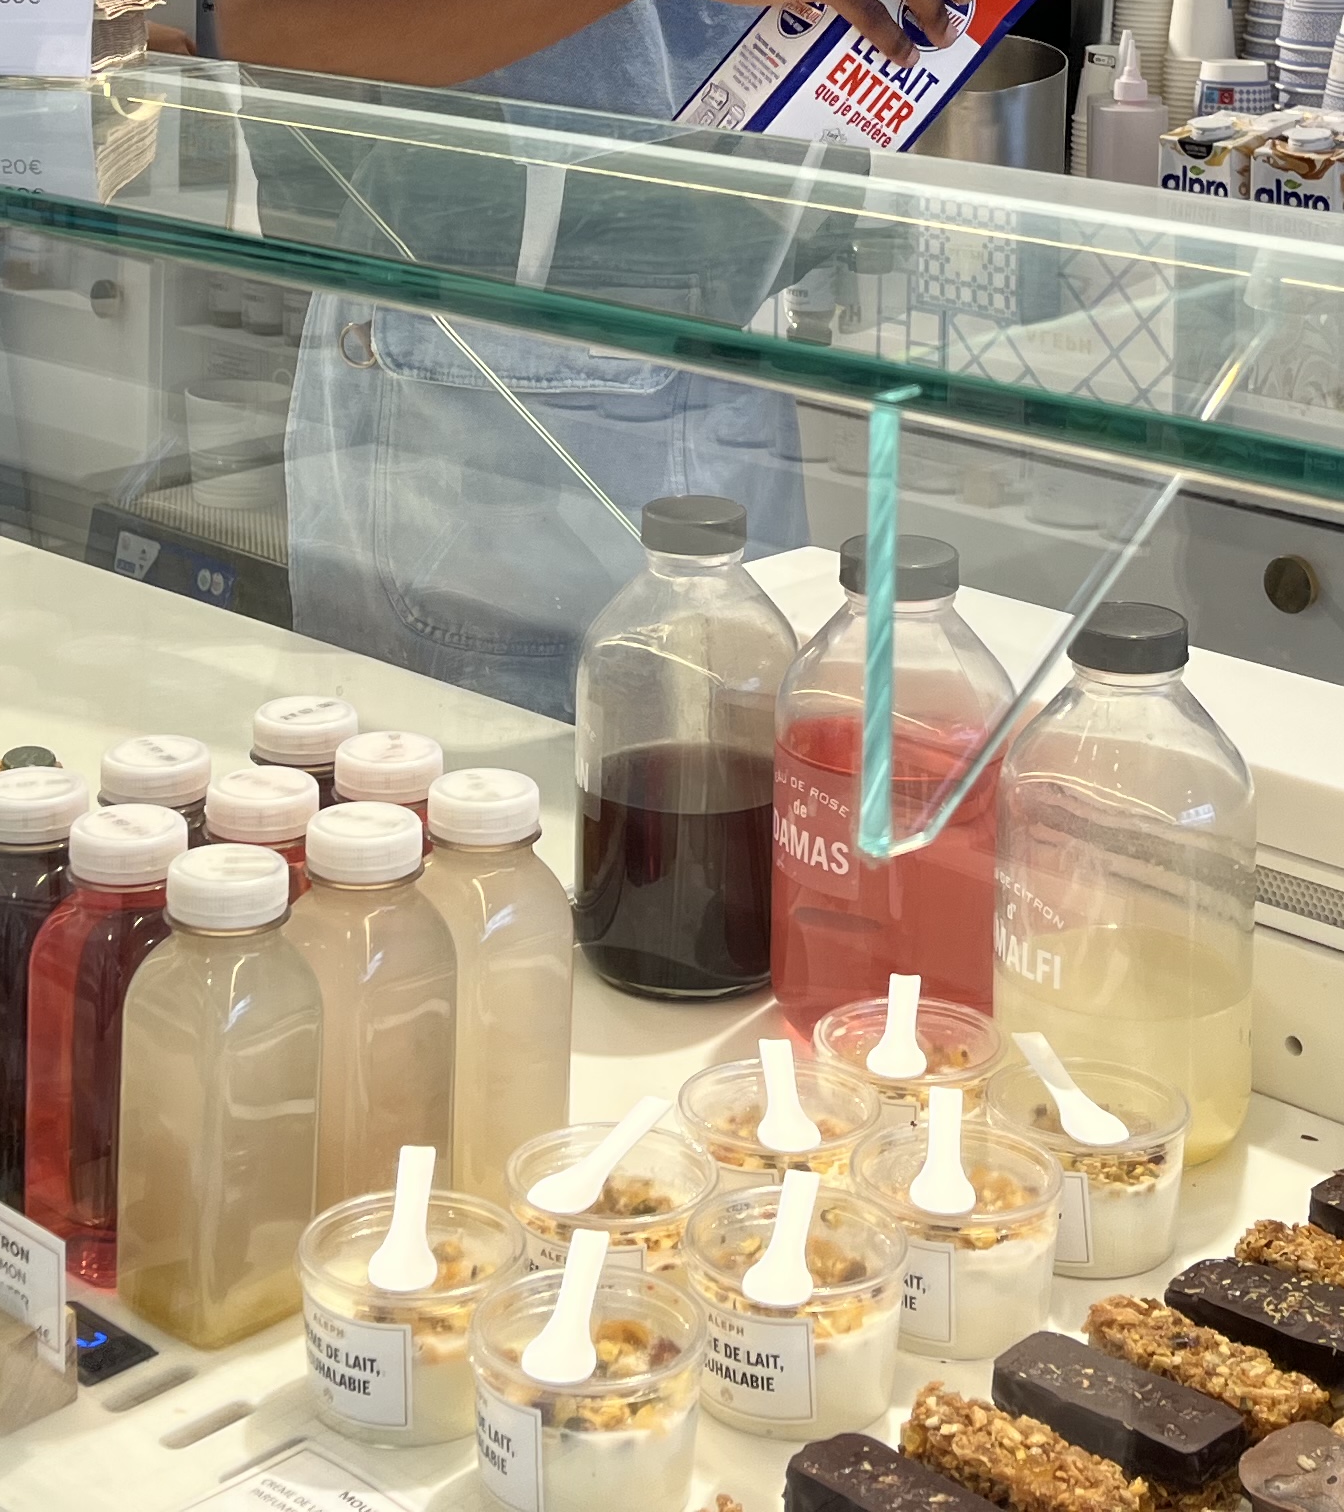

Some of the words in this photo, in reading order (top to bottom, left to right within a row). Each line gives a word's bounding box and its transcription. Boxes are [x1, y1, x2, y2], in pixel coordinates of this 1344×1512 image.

[815, 83, 840, 107] que
[834, 98, 850, 117] je
[847, 109, 892, 148] préfère
[826, 52, 915, 135] ENTIER
[1161, 166, 1229, 199] alpro
[790, 776, 805, 792] DE
[809, 786, 850, 818] ROSE
[773, 806, 850, 875] DAMAS
[1014, 882, 1065, 929] CITRON
[326, 1344, 341, 1363] DE
[345, 1351, 381, 1378] LAIT,
